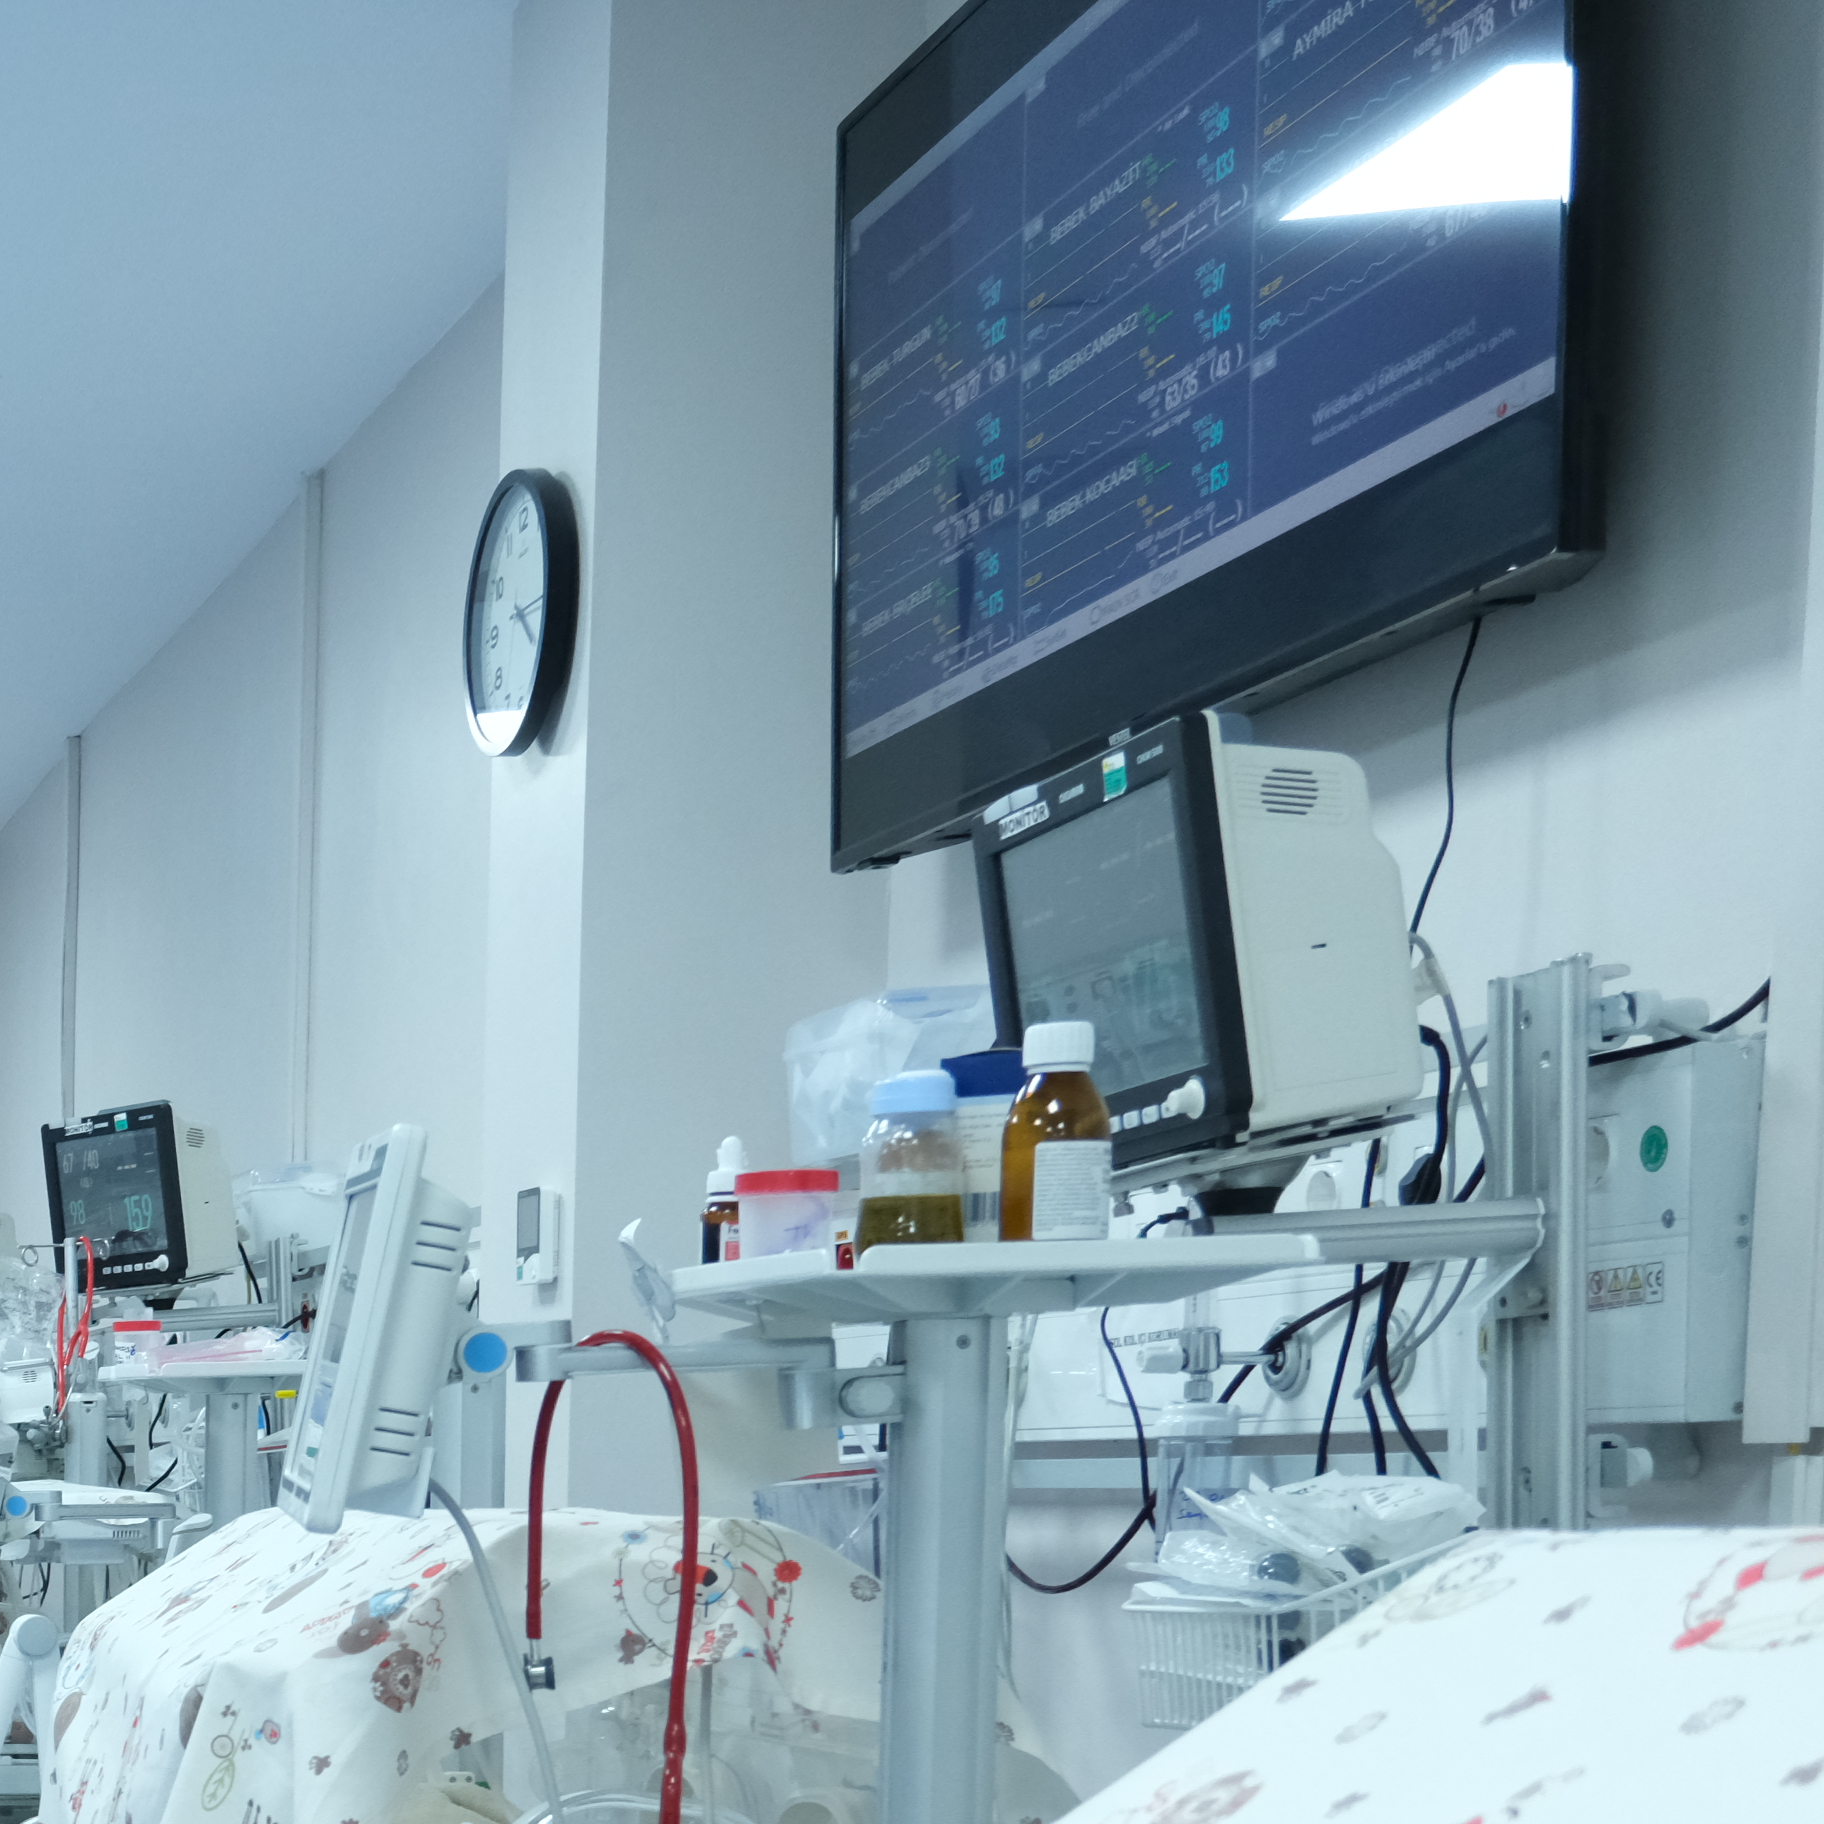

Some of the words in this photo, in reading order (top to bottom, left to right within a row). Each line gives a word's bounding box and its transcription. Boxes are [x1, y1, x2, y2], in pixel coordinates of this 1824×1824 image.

[1449, 3, 1494, 63] 70/38
[1215, 103, 1230, 137] 98
[1215, 145, 1234, 183] 133
[1211, 261, 1225, 295] 97
[990, 314, 1006, 347] 132
[1212, 302, 1231, 339] 145
[1164, 368, 1198, 413] 63/35
[1209, 417, 1223, 449] 99
[989, 451, 1005, 483] 132
[1210, 458, 1229, 494] 153
[518, 506, 529, 532] 12
[506, 534, 513, 558] 11
[494, 576, 504, 601] 10
[490, 625, 499, 649] 9
[494, 667, 503, 691] 8
[62, 1153, 74, 1174] 67
[70, 1199, 86, 1225] 98
[124, 1194, 152, 1232] 159
